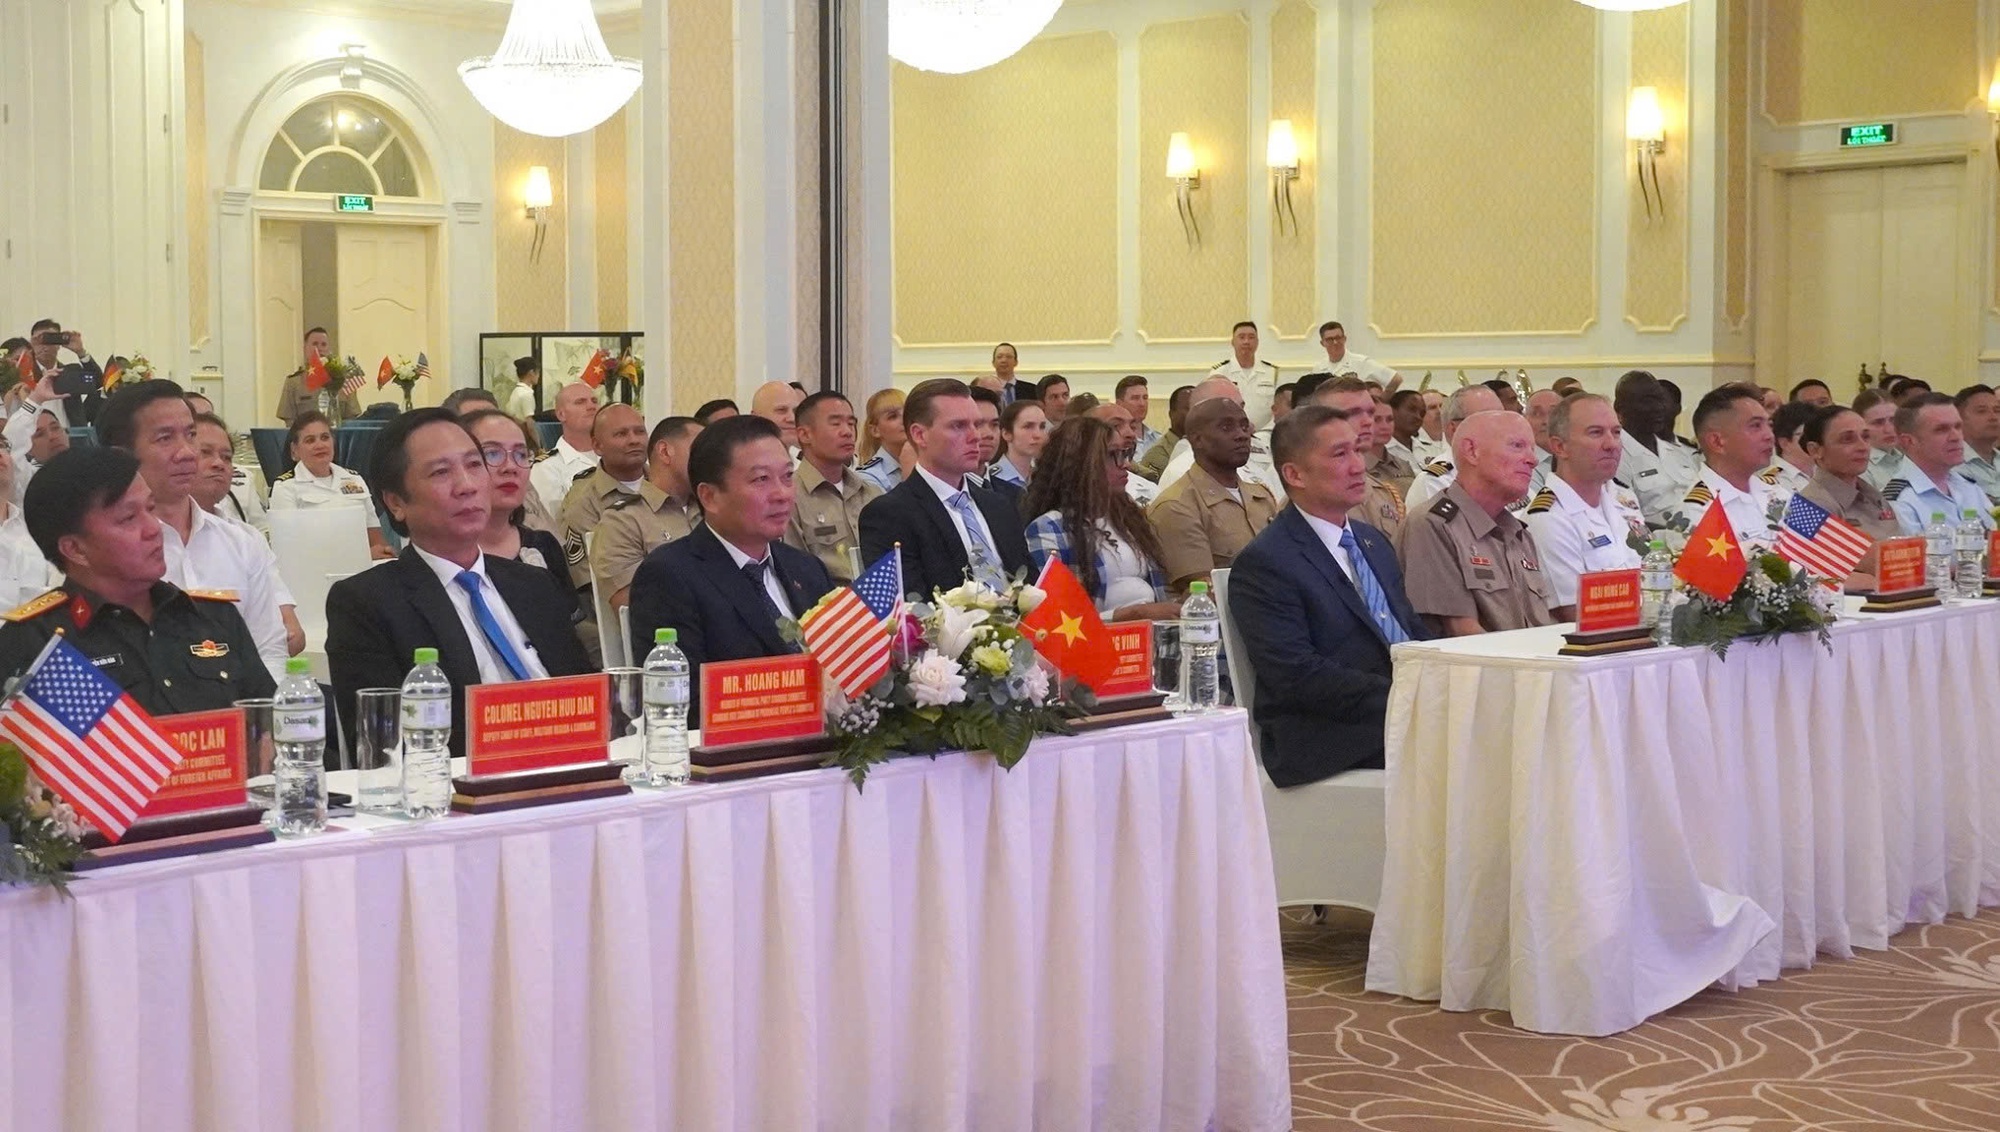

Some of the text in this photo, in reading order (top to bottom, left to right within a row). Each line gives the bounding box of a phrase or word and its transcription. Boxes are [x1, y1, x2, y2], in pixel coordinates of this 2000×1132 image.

[1851, 125, 1883, 137] EXIT
[1121, 633, 1140, 650] VINH
[722, 668, 805, 695] MR. HOANG NAM
[484, 695, 595, 725] COLONEL NGUYEN HUU DAN
[200, 727, 226, 751] LAN
